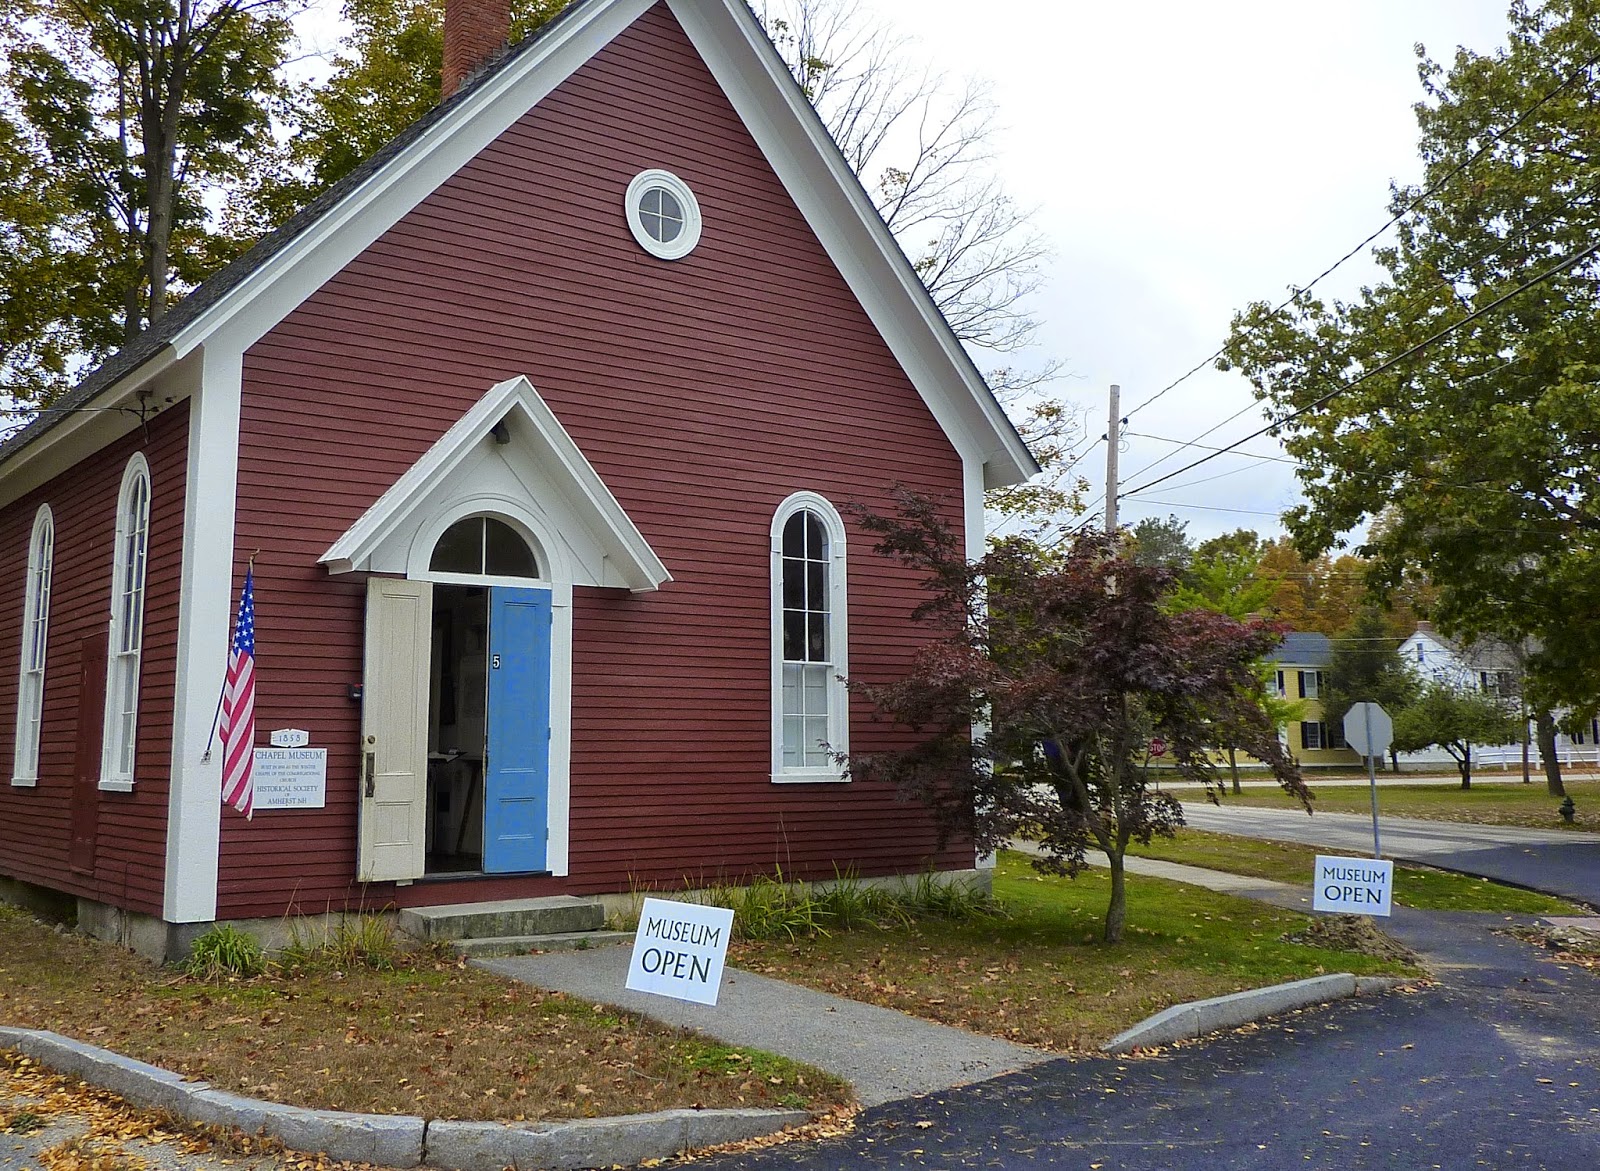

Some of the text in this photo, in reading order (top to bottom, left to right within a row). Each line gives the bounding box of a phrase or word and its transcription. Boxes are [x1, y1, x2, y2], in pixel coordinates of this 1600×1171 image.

[493, 655, 500, 668] 5
[255, 751, 323, 760] CHAPEL MUSEUM
[256, 785, 291, 793] HISTORICAL
[1323, 866, 1386, 884] MUSEUM
[1324, 885, 1382, 904] OPEN
[645, 916, 721, 948] MUSEUM
[641, 948, 712, 983] OPEN
